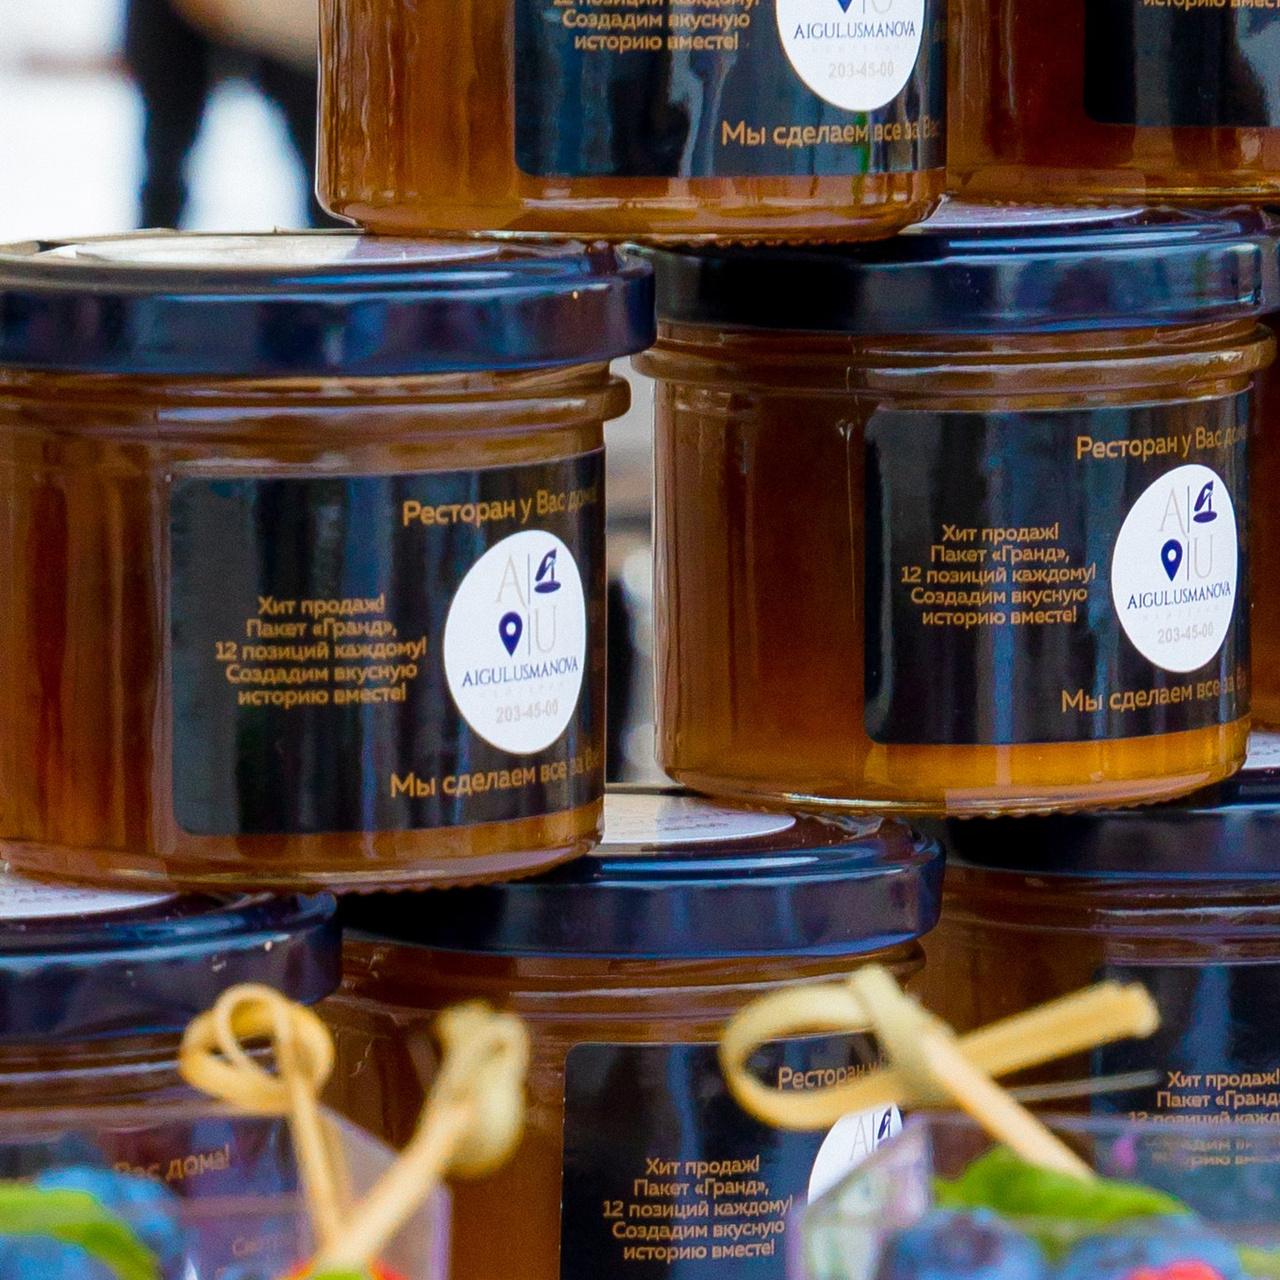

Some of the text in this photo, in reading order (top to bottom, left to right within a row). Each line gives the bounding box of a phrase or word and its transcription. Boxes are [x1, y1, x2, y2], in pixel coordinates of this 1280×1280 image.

[563, 10, 750, 32] Создадим вкусную
[575, 34, 739, 54] историю вместе!
[722, 121, 765, 145] Мы
[773, 123, 868, 150] сделаем
[1077, 435, 1178, 462] Ресторан
[1182, 434, 1192, 458] у
[1196, 426, 1222, 450] Вас
[403, 497, 515, 527] Ресторан
[520, 498, 532, 524] у
[536, 490, 565, 516] Вас
[943, 522, 1059, 544] Хит продаж!
[931, 545, 1069, 565] Пакет «Гранд»,
[901, 563, 1096, 584] 12 позиций каждому!
[258, 593, 385, 616] Хит продаж!
[911, 585, 1087, 605] Создадим вкусную
[922, 606, 1077, 627] историю вместе!
[246, 618, 397, 640] Пакет «Гранд»,
[216, 637, 427, 663] 12 позиций каждому!
[226, 663, 417, 685] Создадим вкусную
[238, 684, 406, 709] историю вместе!
[1061, 688, 1102, 713] Мы
[1110, 686, 1192, 712] сделаем
[1197, 680, 1220, 700] все
[390, 772, 435, 798] Мы
[442, 768, 535, 798] сделаем
[540, 761, 567, 783] все
[1167, 1068, 1280, 1091] Хит продаж!
[1157, 1092, 1210, 1107] Пакет
[165, 1142, 231, 1182] дома!
[646, 1155, 760, 1178] Хит продаж!
[634, 1178, 769, 1199] Пакет «Гранд»,
[603, 1195, 792, 1219] 12 позиций каждому!
[612, 1220, 785, 1240] Создадим вкусную
[624, 1239, 774, 1263] историю вместе!
